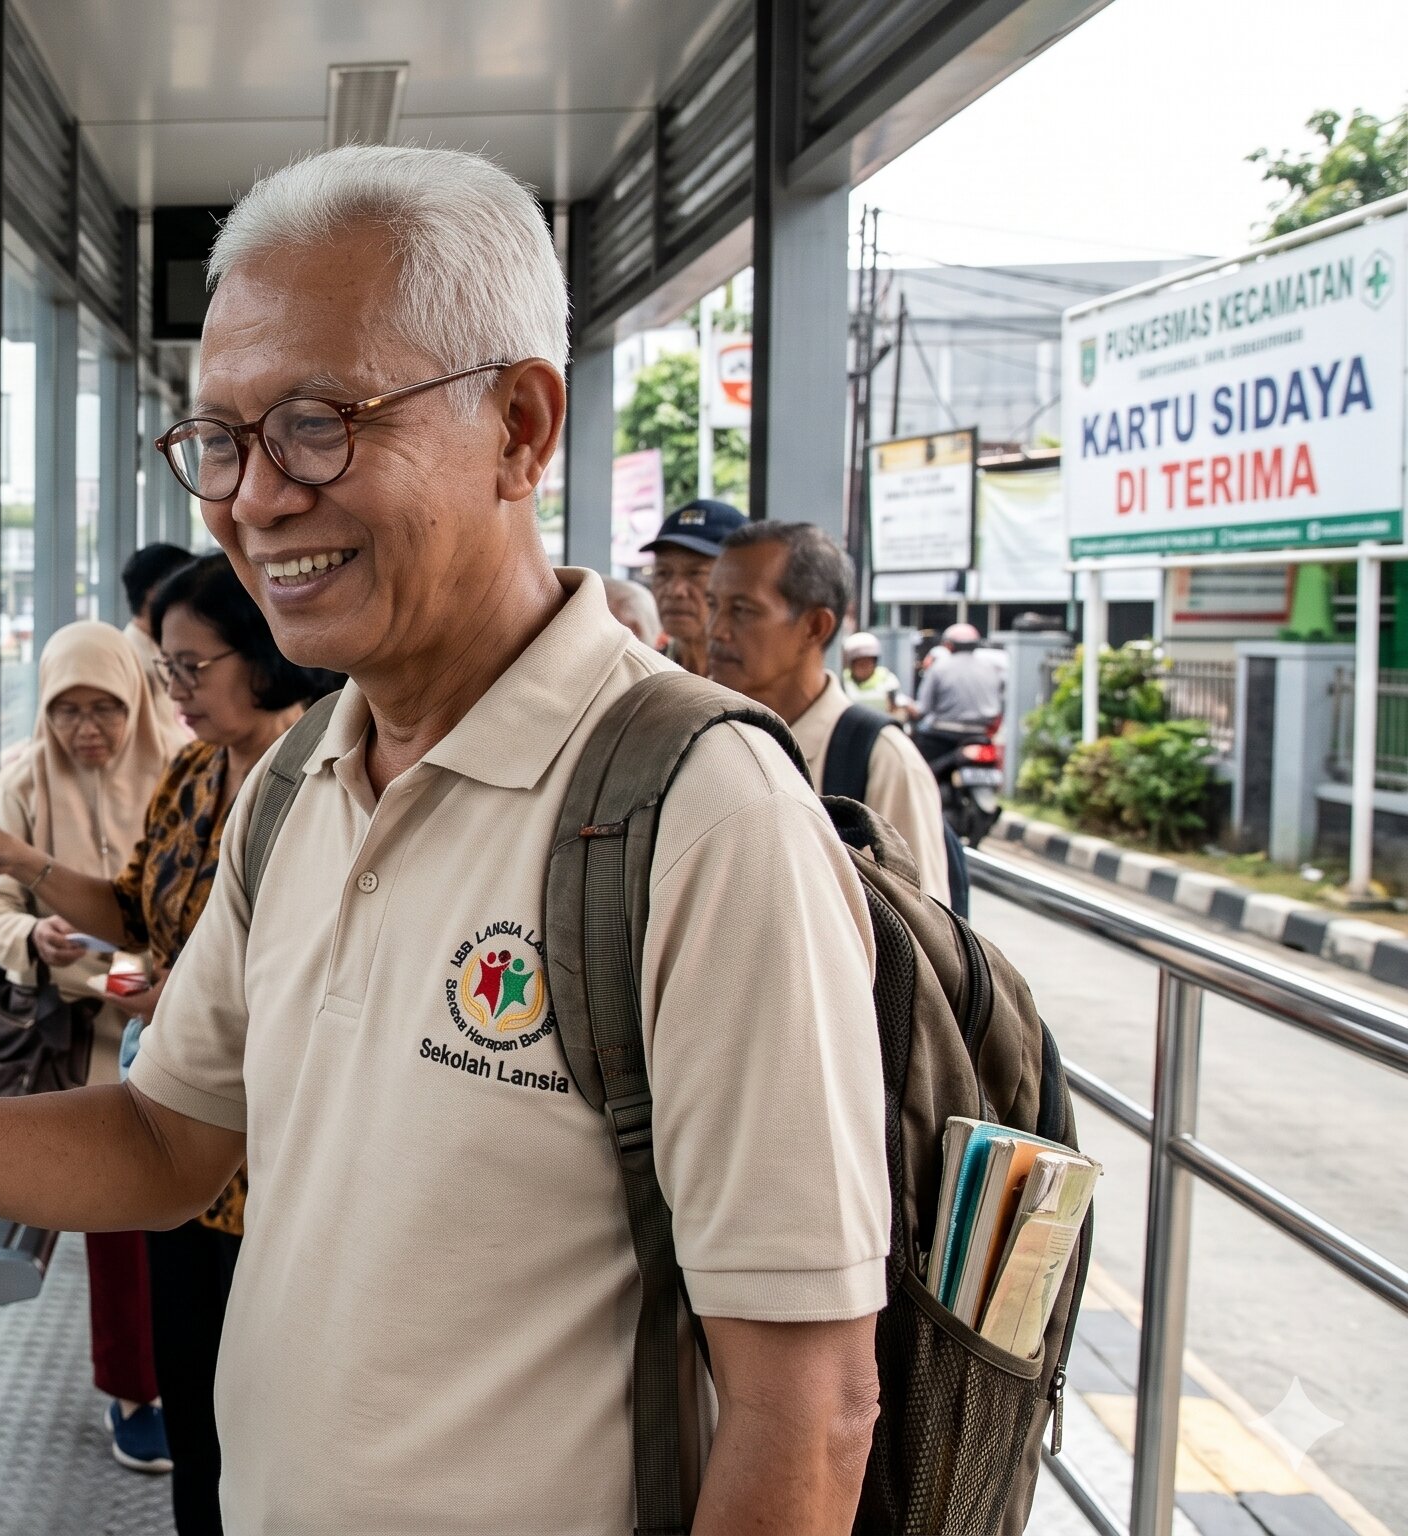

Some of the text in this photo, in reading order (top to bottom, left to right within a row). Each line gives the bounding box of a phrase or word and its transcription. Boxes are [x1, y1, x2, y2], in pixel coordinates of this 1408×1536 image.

[1104, 302, 1213, 363] PUSKESMAS
[1217, 257, 1354, 331] KECAMATAN
[1081, 393, 1197, 459] KARTU
[1211, 354, 1374, 437] SIDAYA
[1115, 442, 1318, 517] DI TERIMA
[476, 921, 523, 944] LANSIA
[419, 1038, 569, 1093] Sekolah Lansia
